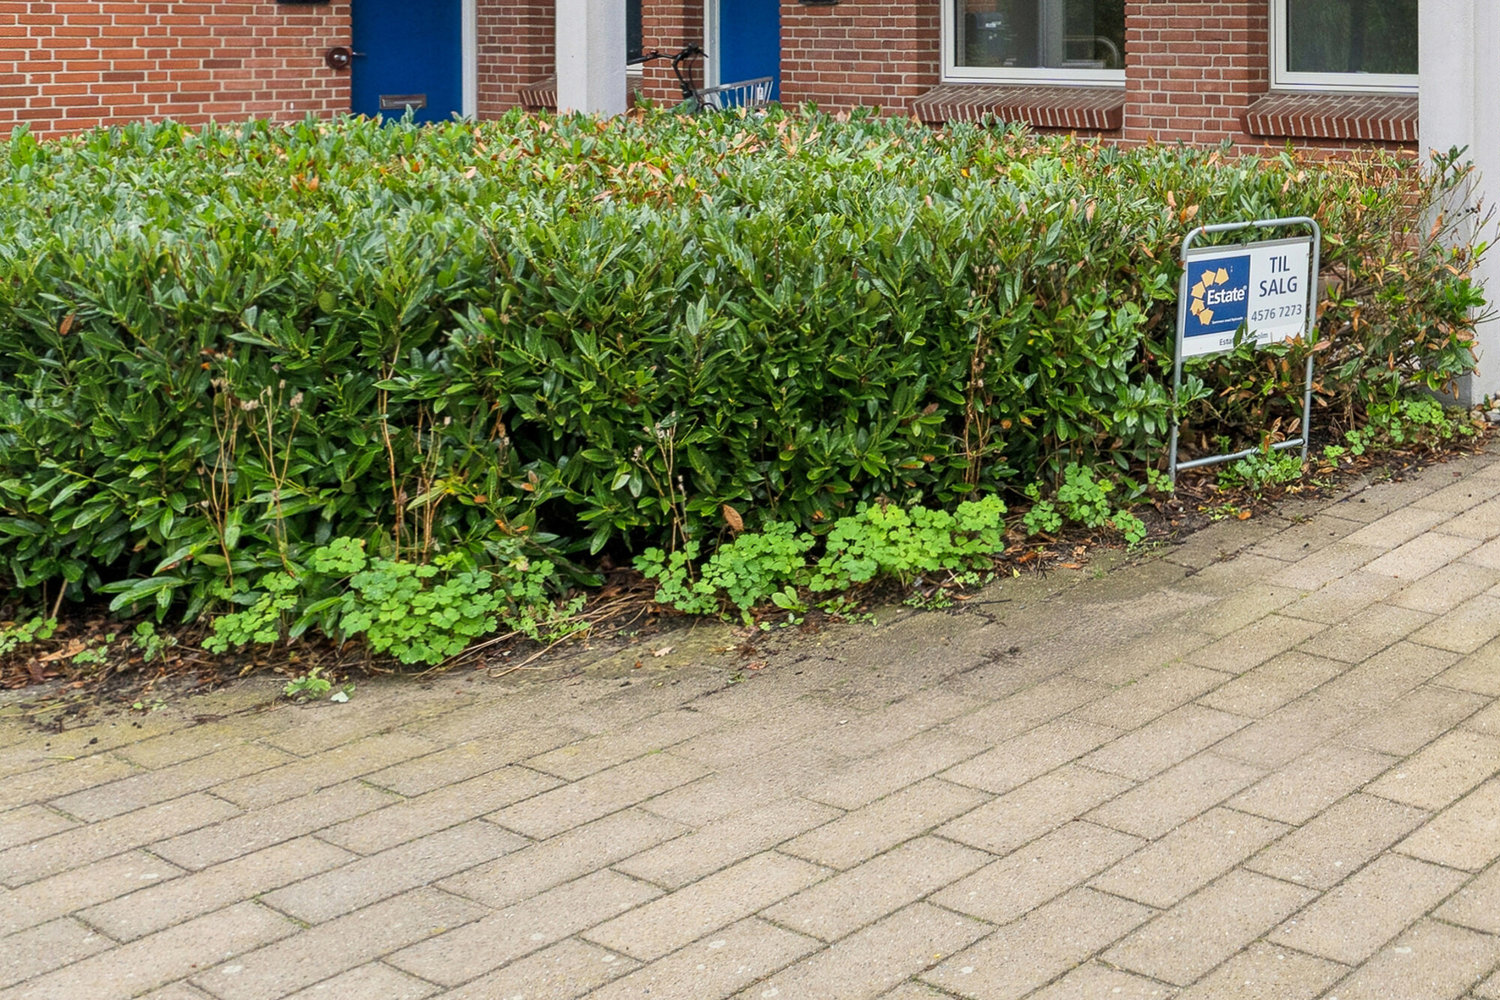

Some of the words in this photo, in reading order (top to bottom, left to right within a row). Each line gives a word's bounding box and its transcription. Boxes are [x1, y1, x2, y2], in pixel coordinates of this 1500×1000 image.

[1269, 255, 1290, 274] TIL
[1207, 287, 1246, 305] Estate
[1259, 276, 1298, 298] SALG
[1251, 307, 1276, 322] 4576
[1279, 304, 1303, 318] 7273
